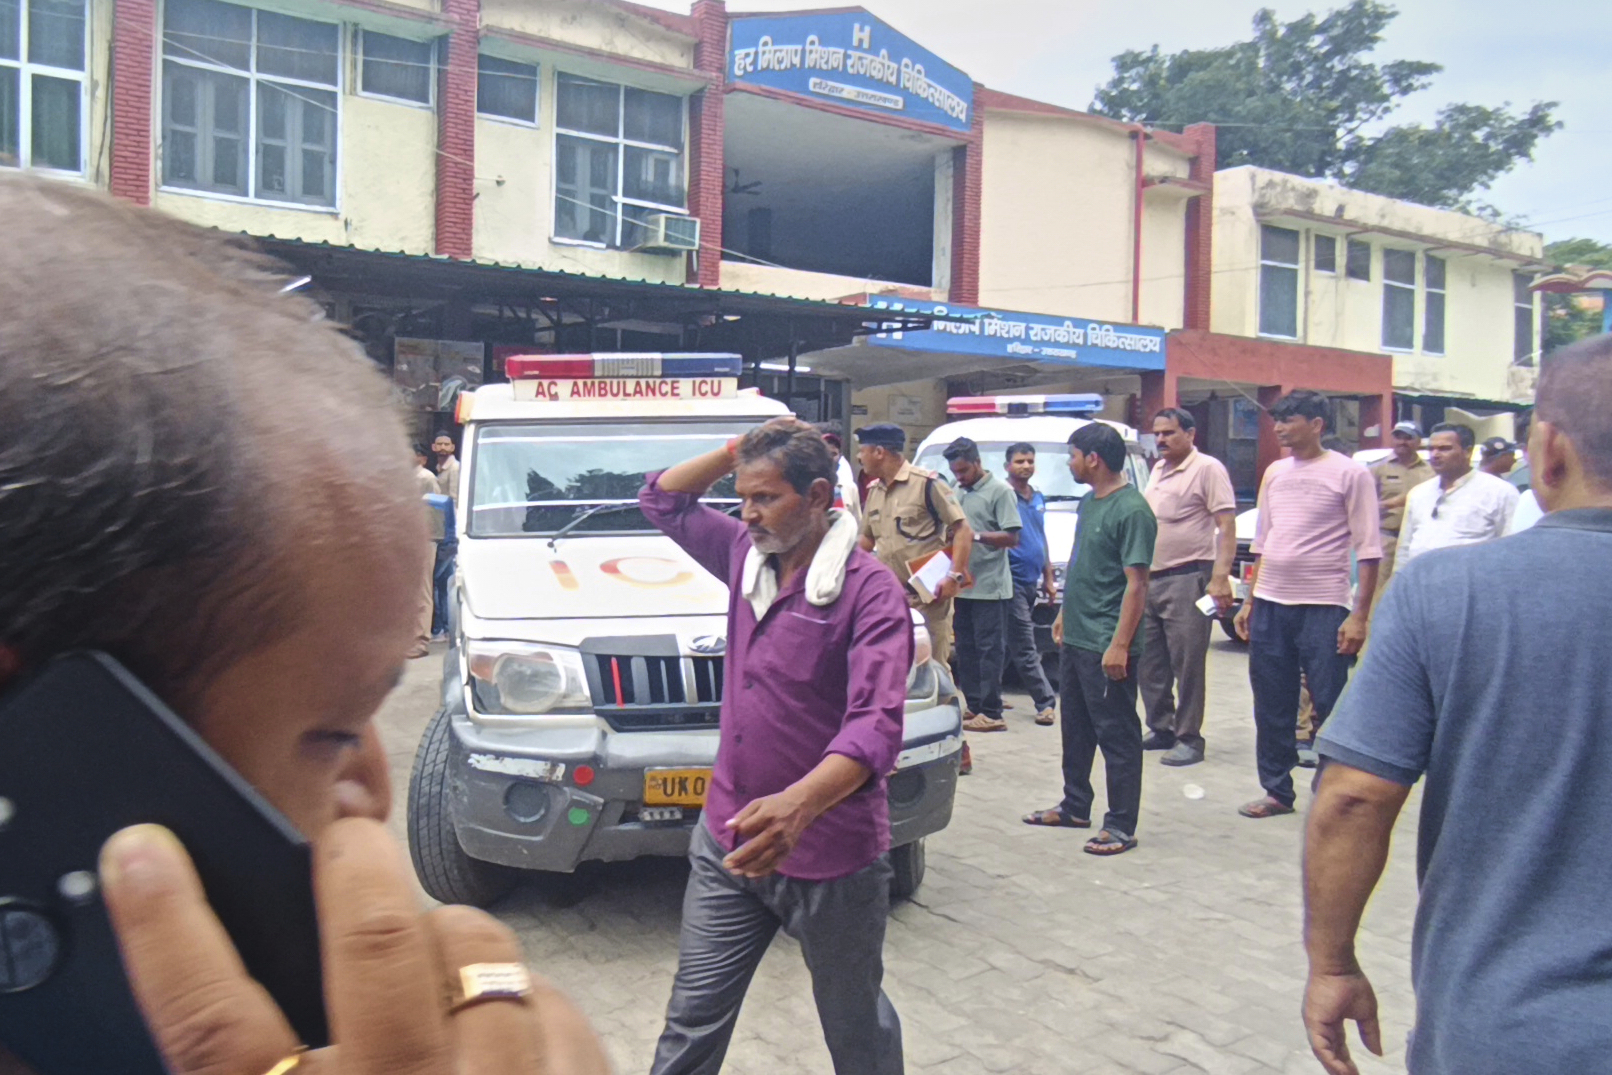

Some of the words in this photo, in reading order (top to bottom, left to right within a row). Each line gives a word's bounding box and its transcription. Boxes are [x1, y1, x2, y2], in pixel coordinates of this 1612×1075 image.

[852, 23, 871, 49] H
[734, 47, 756, 76] हर
[758, 35, 802, 71] मिलाप
[805, 35, 844, 72] मिशन
[847, 49, 898, 85] राजकीय
[900, 57, 967, 122] चिकित्सालय
[984, 311, 1027, 339] मिशन
[1028, 320, 1085, 346] राजकीय
[1086, 323, 1161, 353] चिकित्सालय
[535, 381, 559, 398] AC
[570, 380, 681, 398] AMBULANCE
[691, 380, 722, 397] ICU
